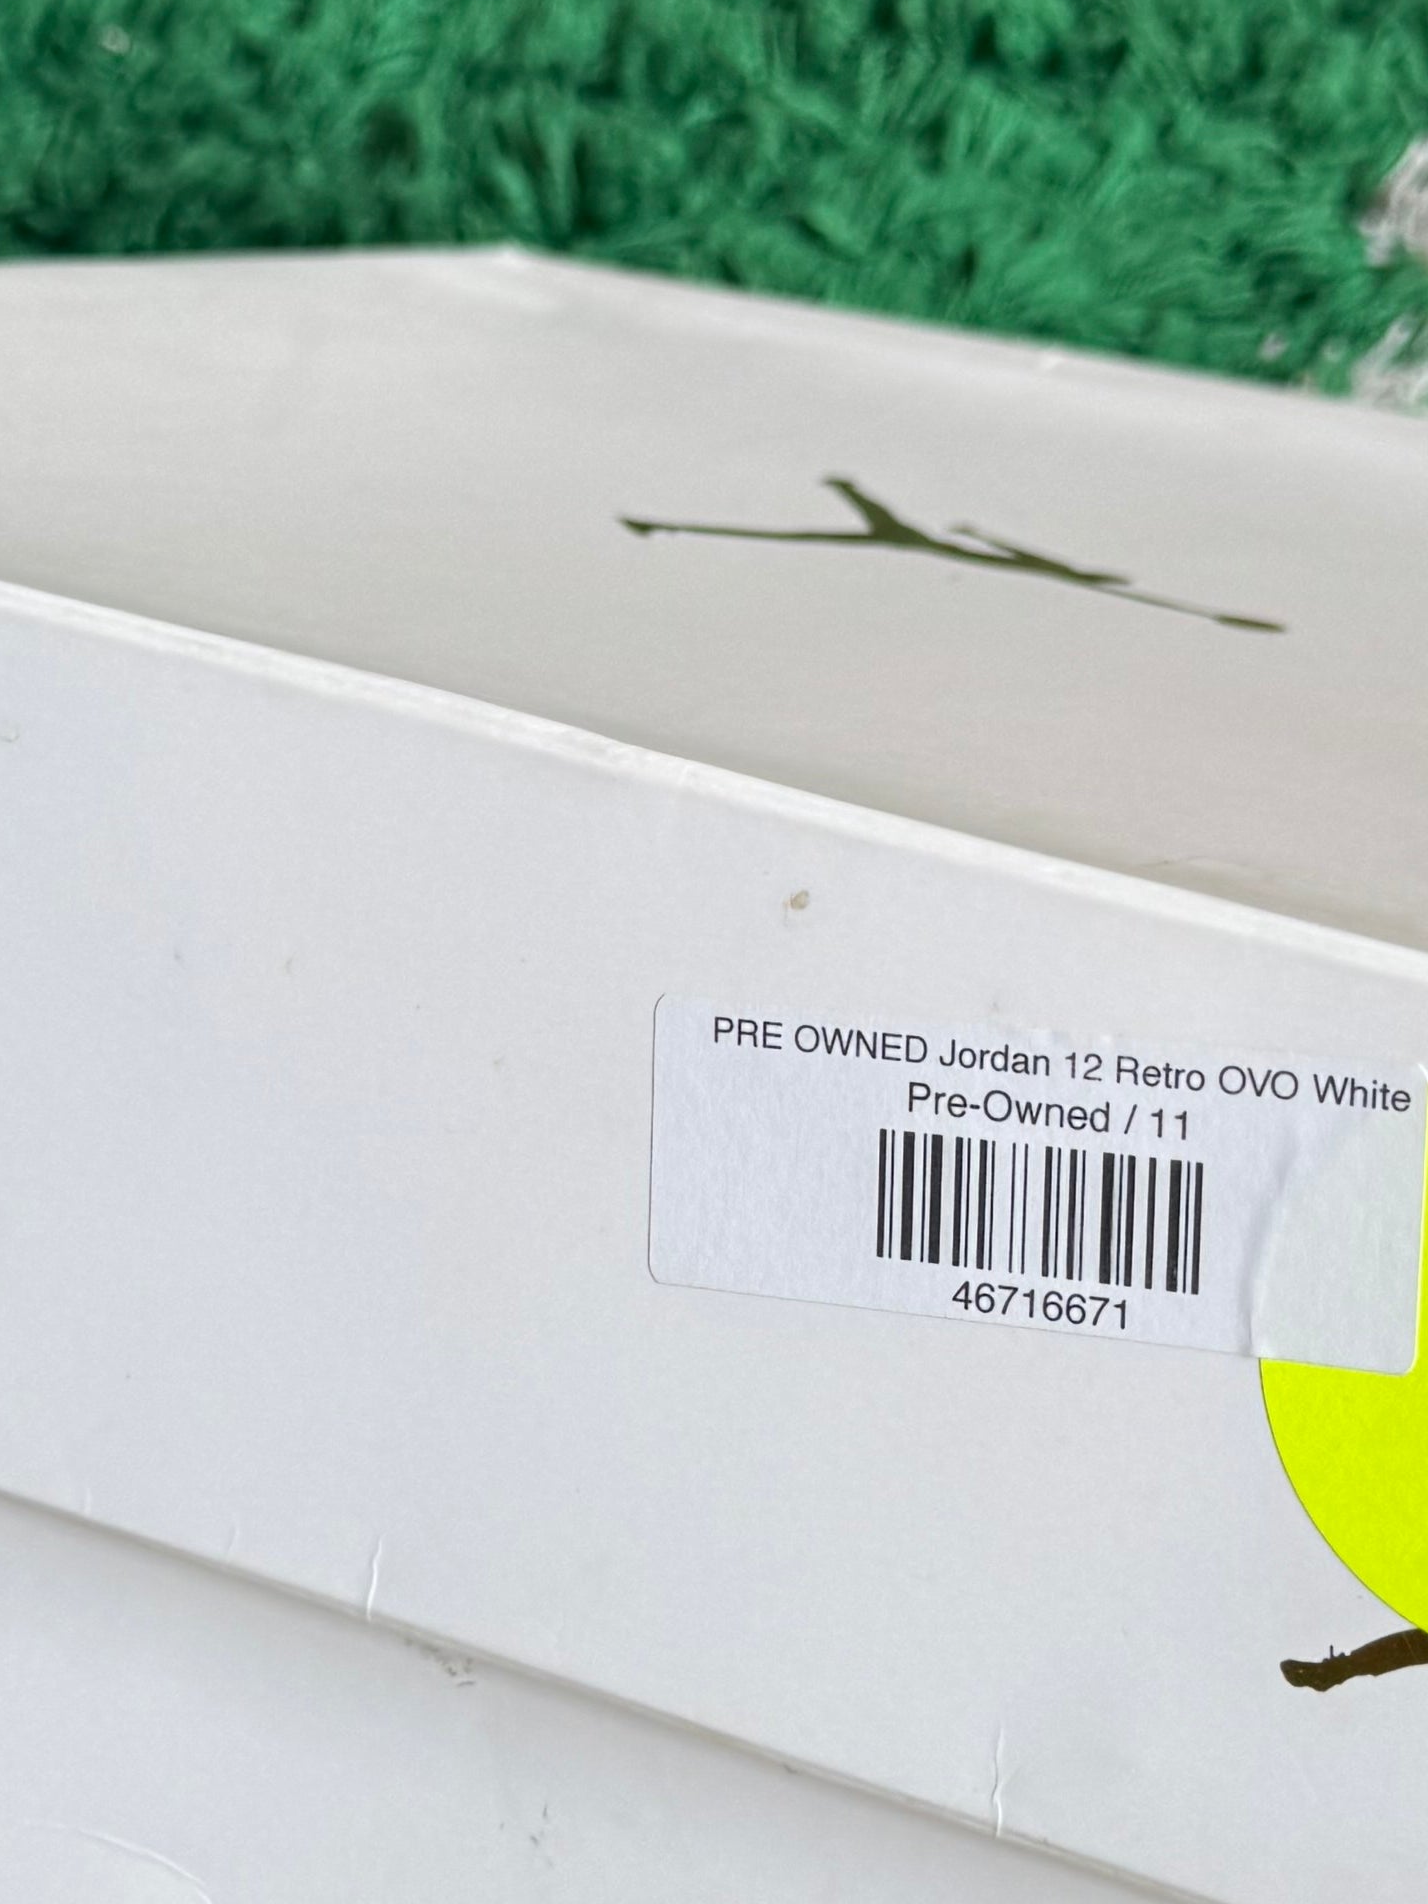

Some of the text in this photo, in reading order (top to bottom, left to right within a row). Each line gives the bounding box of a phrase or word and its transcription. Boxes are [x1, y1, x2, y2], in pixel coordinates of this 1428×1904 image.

[713, 1016, 1412, 1113] PRE OWNED Jordan 12 Retro OVO White
[907, 1081, 1189, 1141] Pre-Owned / 11
[952, 1281, 1130, 1330] 46716671
